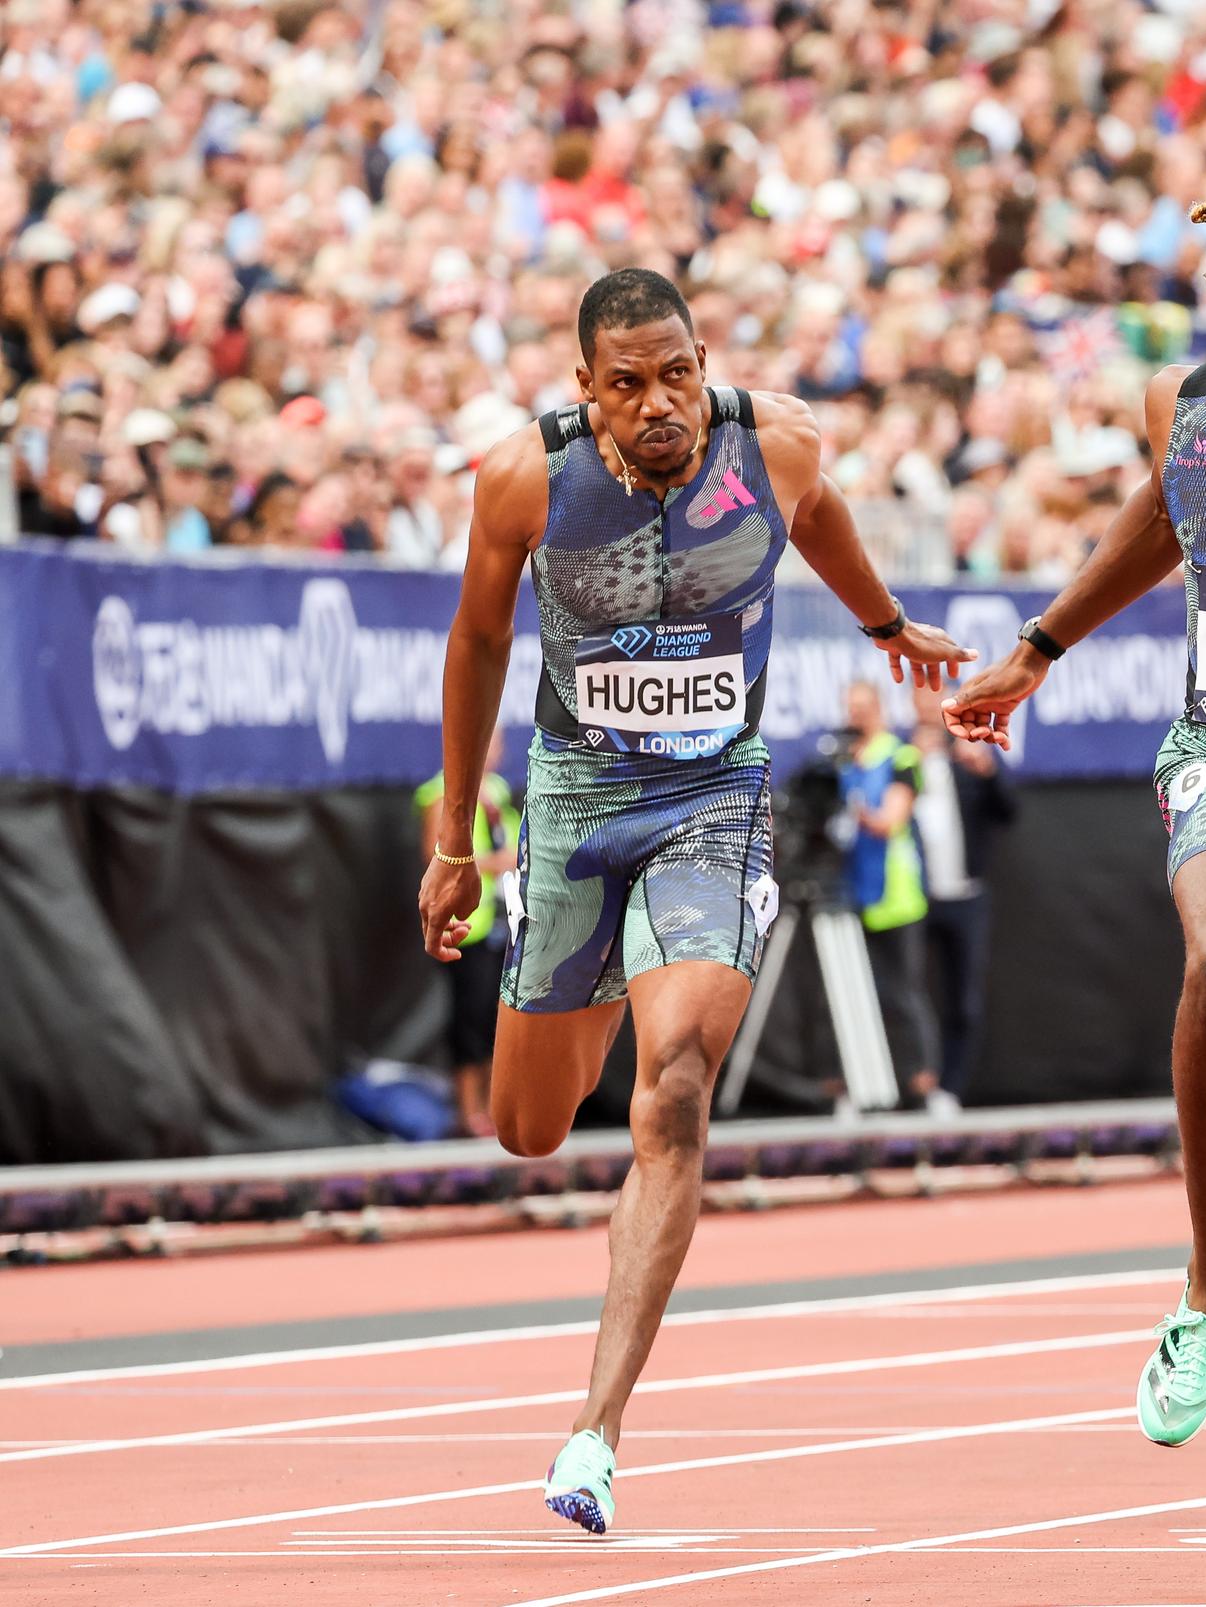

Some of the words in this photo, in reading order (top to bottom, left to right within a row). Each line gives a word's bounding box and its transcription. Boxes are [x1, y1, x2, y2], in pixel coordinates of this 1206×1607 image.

[655, 631, 712, 647] DIAMOND
[652, 644, 701, 657] LEAGUE
[586, 671, 736, 716] HUGHES
[639, 733, 725, 755] LONDON
[1181, 767, 1202, 793] 6
